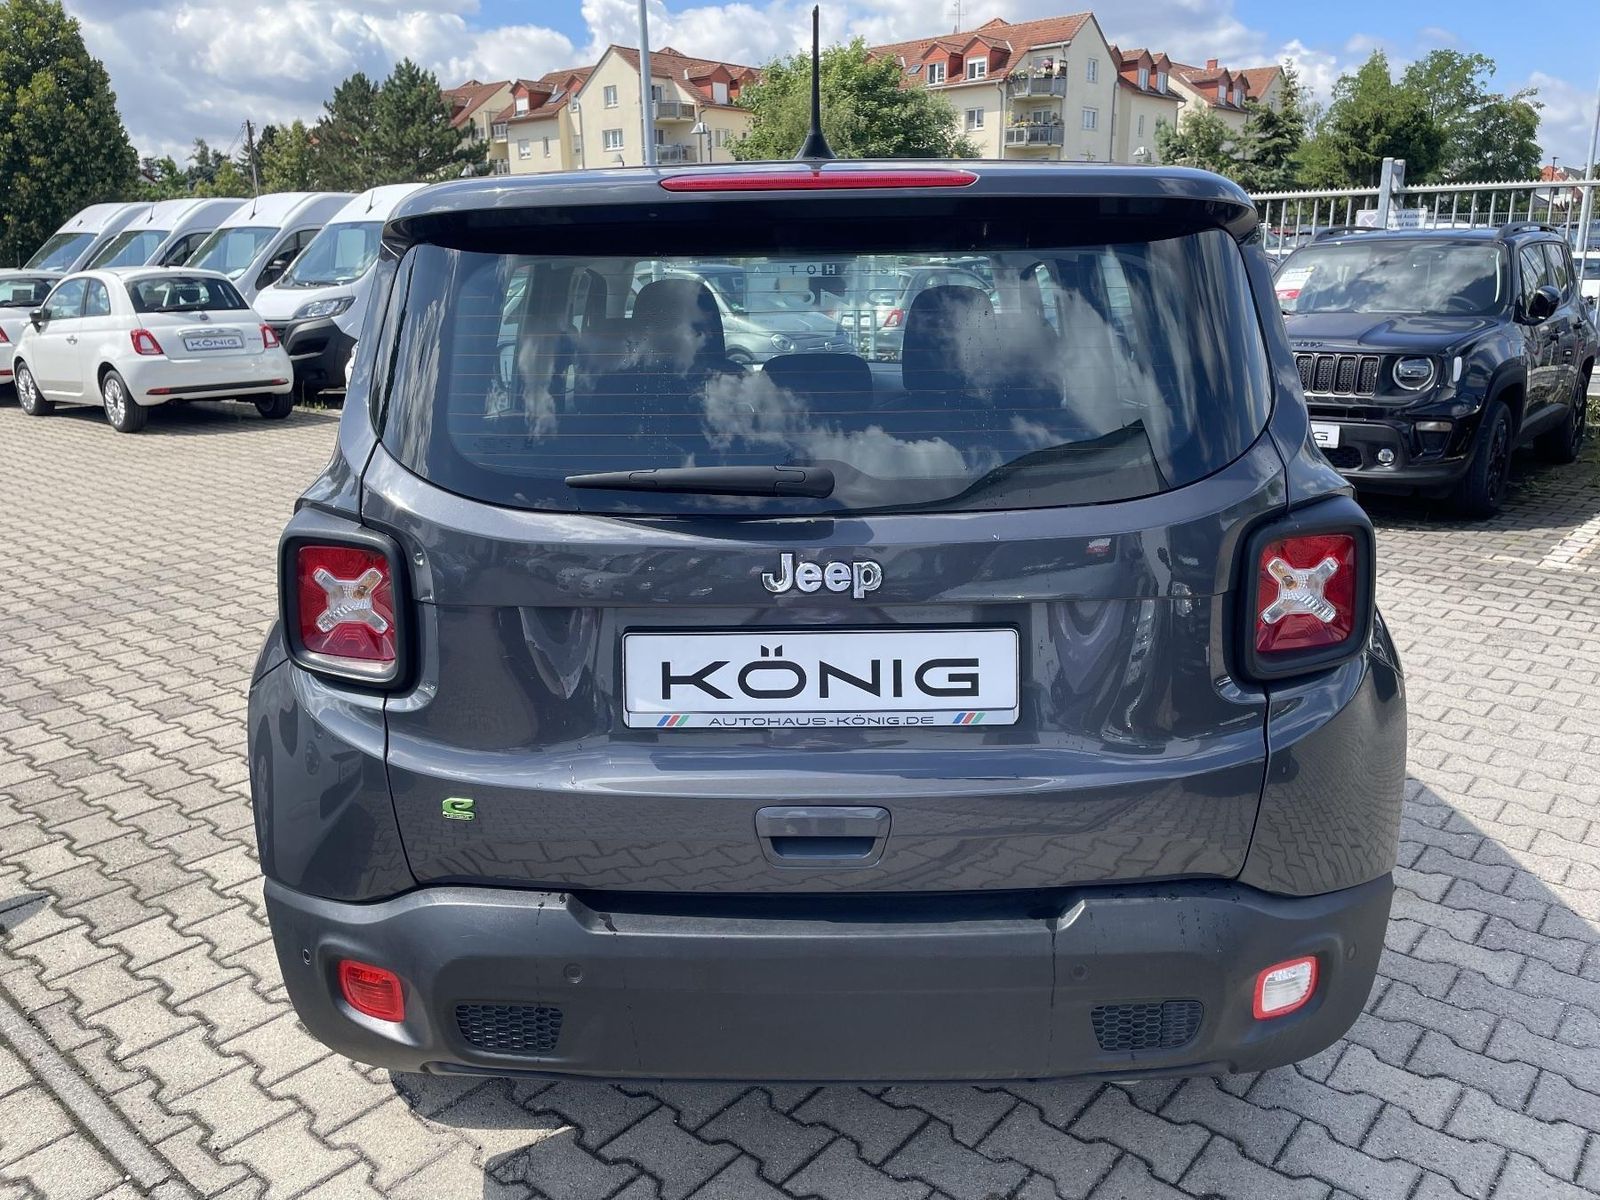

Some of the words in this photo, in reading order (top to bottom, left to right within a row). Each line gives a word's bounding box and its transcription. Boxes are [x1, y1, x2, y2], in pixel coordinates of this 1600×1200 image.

[761, 552, 882, 599] Jeep
[661, 644, 980, 700] KÖNIG
[708, 714, 935, 726] AUTOHAUS-KÖNIG.DE
